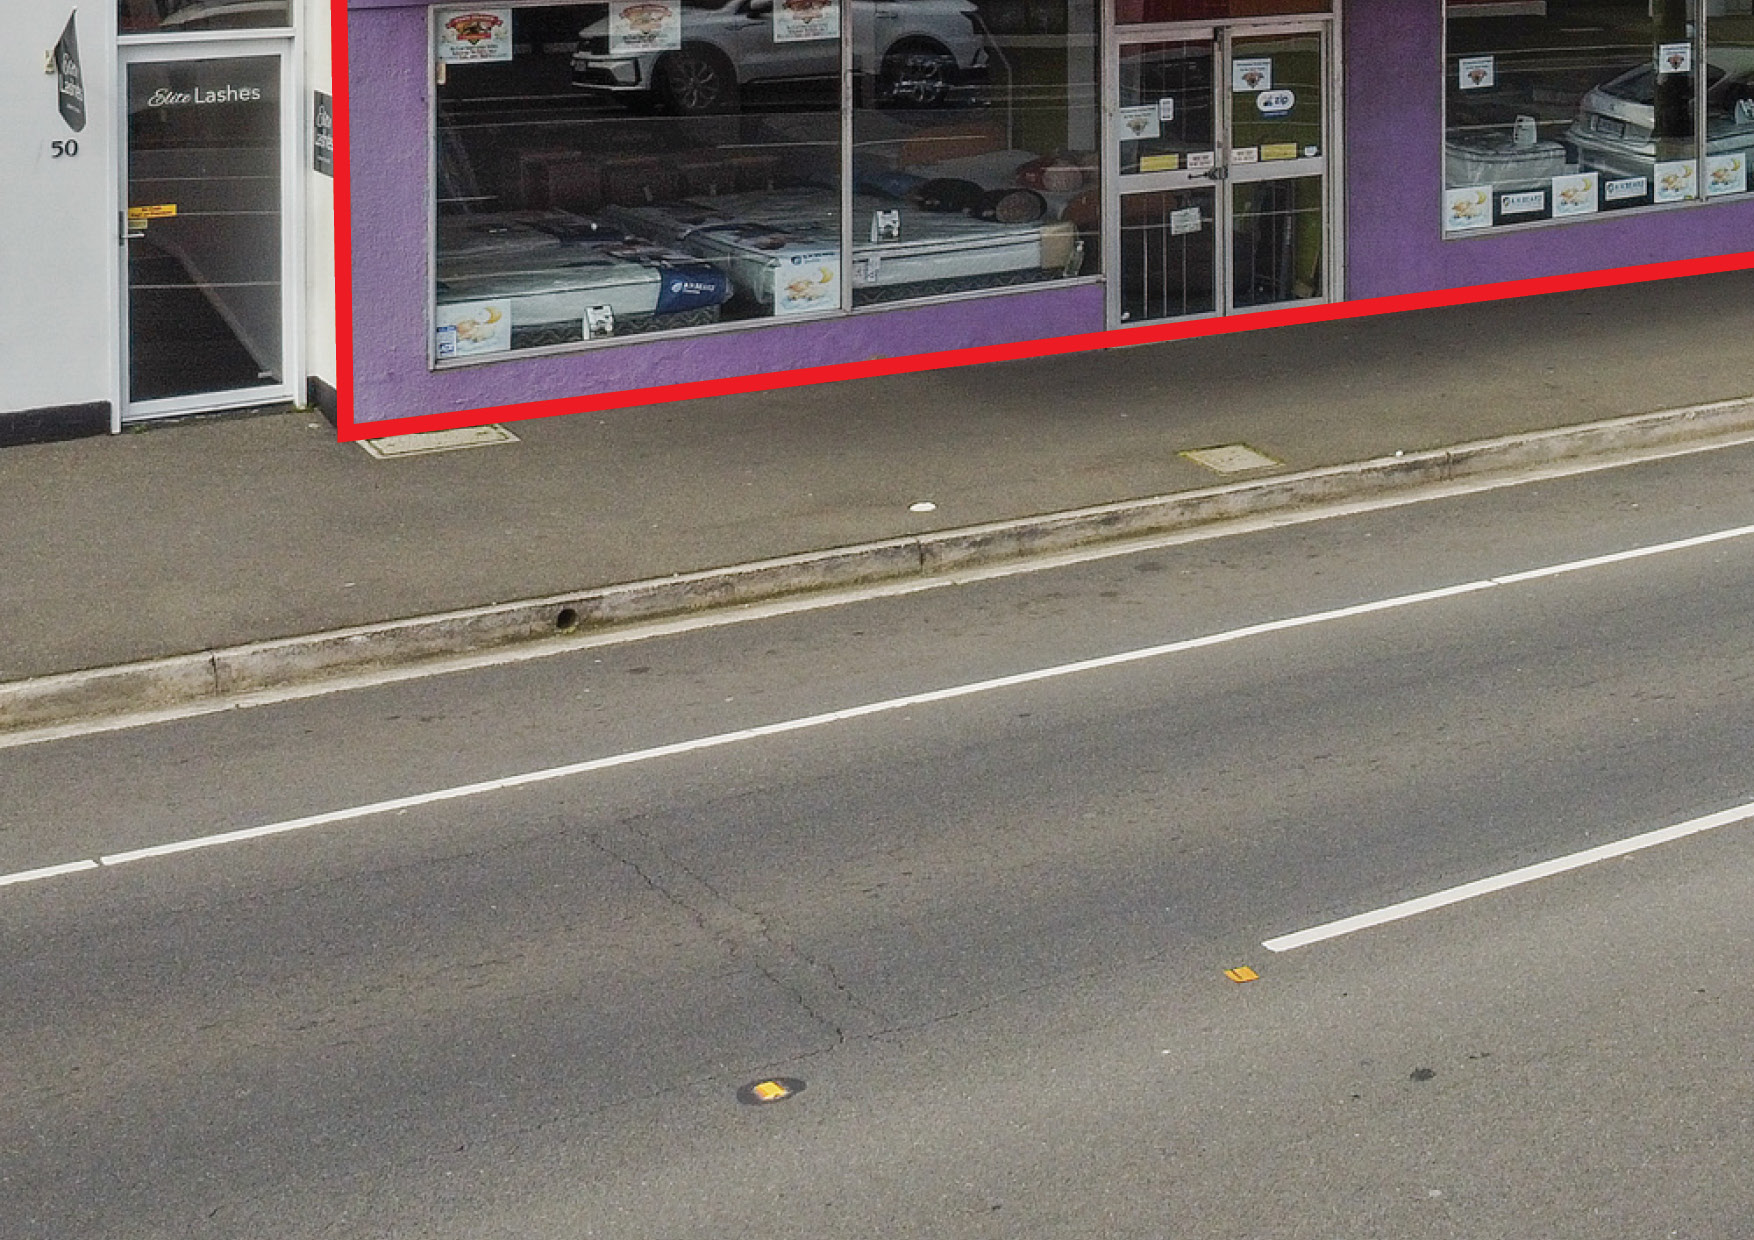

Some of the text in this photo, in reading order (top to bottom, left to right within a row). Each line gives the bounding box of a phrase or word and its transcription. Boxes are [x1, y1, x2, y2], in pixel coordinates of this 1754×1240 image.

[147, 84, 262, 107] Elite Lashes
[51, 138, 79, 159] 50
